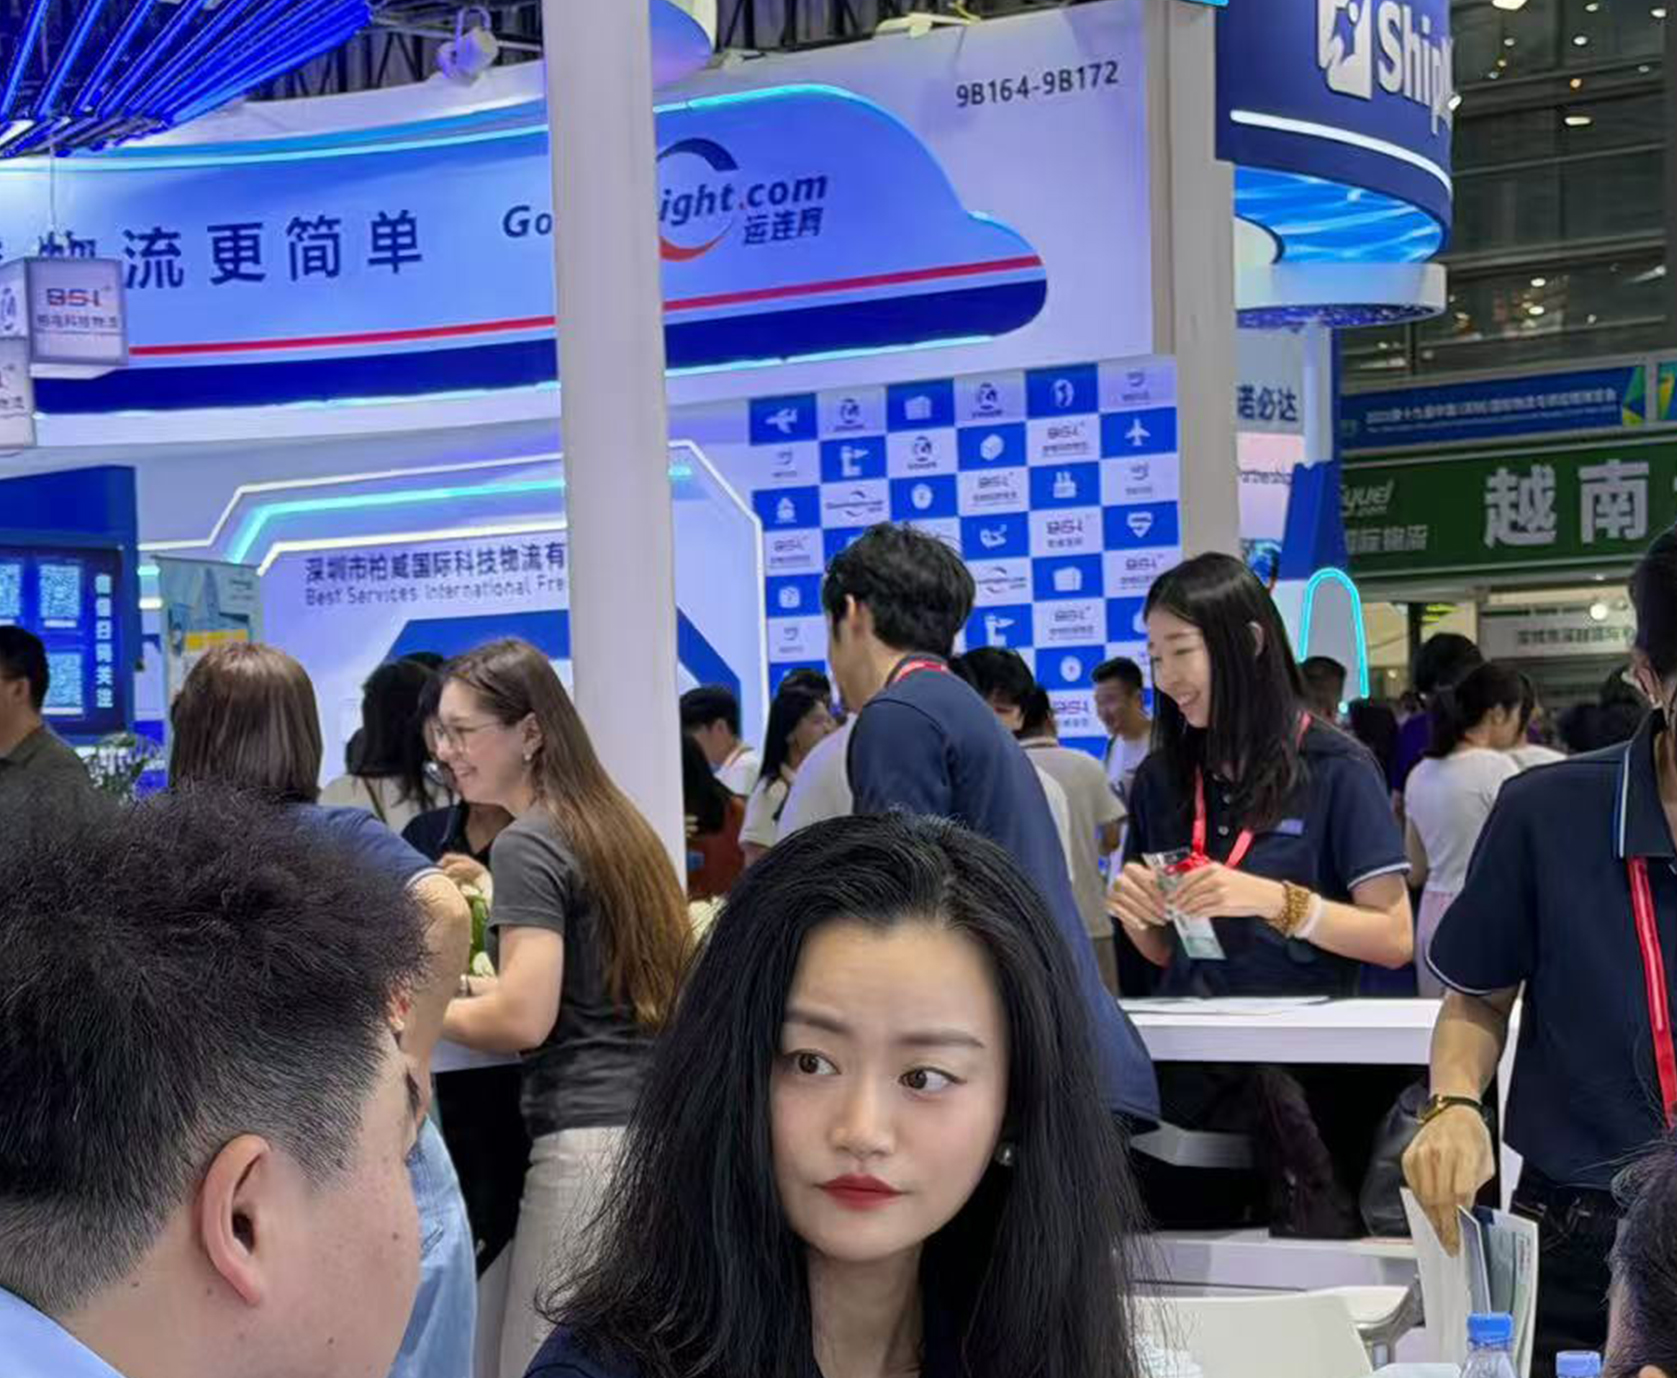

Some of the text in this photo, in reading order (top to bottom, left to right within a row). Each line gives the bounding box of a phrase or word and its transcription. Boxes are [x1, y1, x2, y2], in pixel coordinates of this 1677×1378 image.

[956, 61, 1118, 107] 9B164-9B172
[744, 207, 824, 245] 运连网
[1484, 458, 1677, 549] 越南
[305, 587, 341, 606] Best
[348, 585, 417, 604] Services
